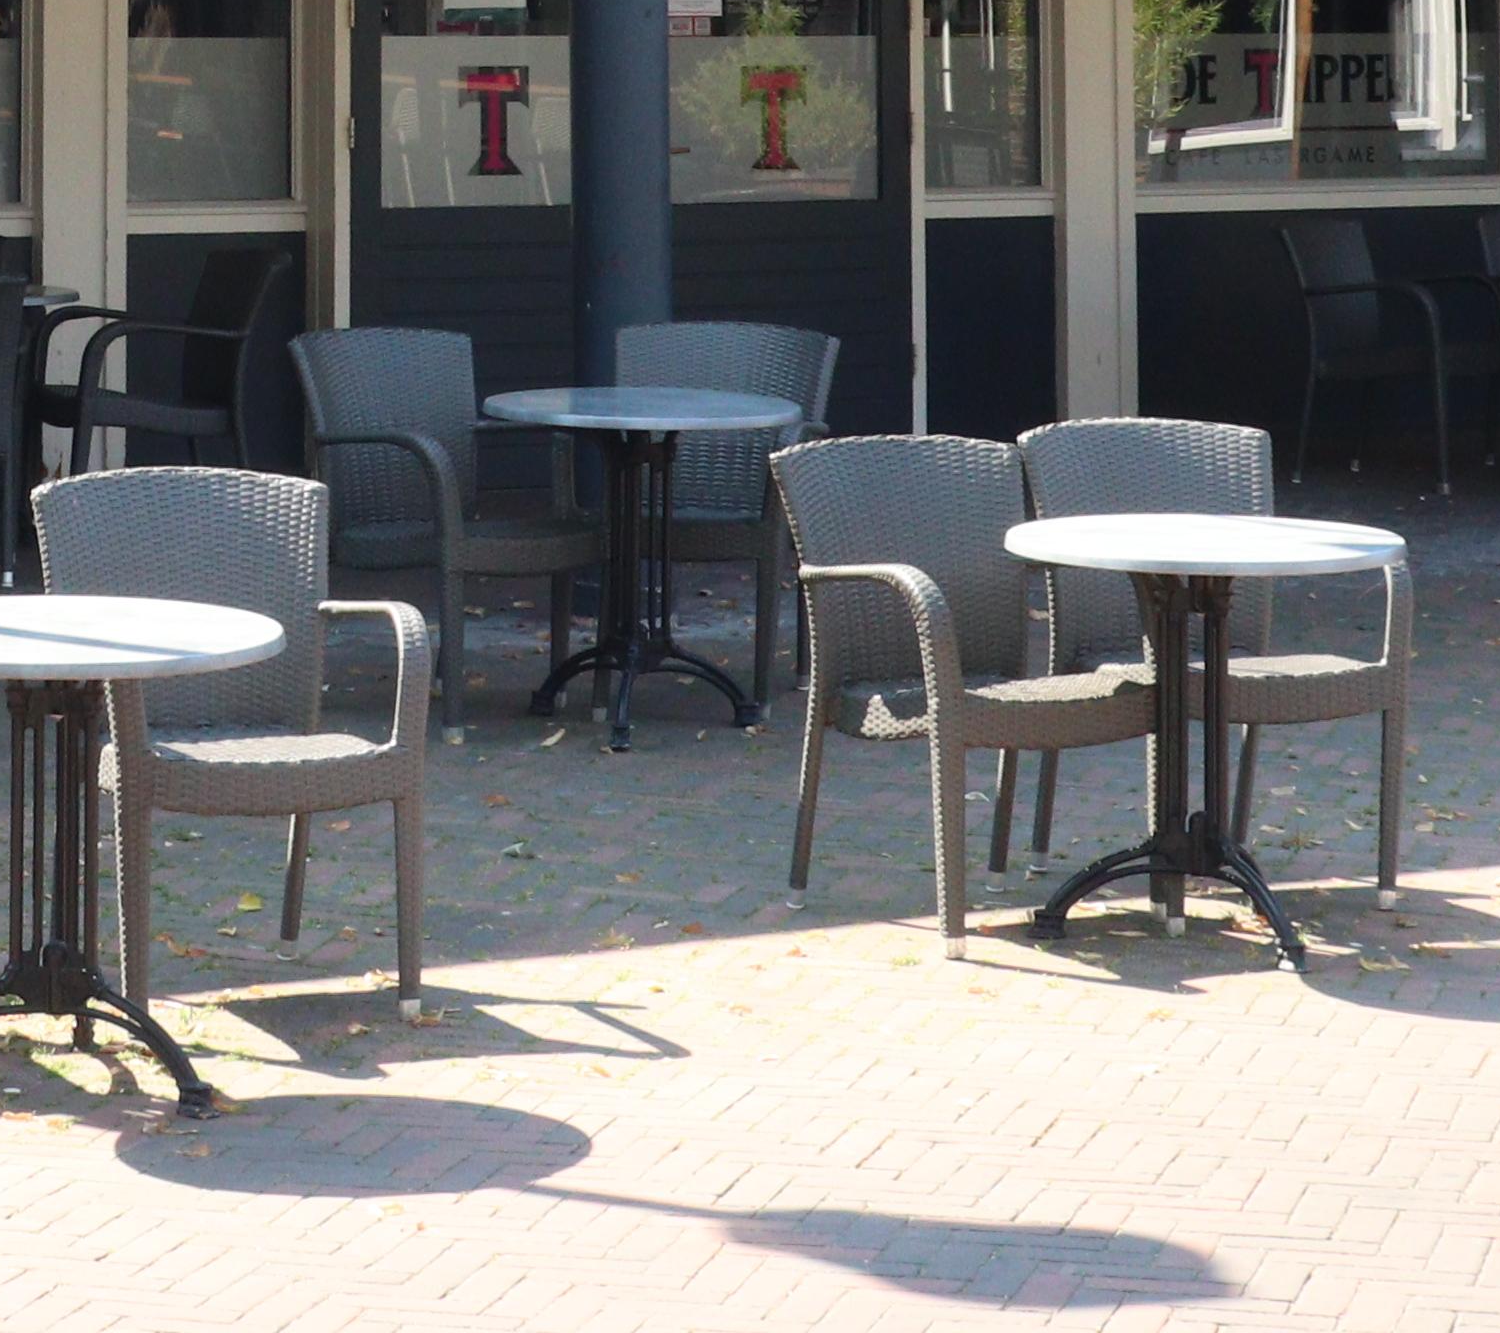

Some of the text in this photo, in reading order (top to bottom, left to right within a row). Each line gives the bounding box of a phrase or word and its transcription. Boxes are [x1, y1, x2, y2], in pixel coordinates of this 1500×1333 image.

[458, 65, 529, 176] T
[739, 64, 806, 171] T
[1245, 145, 1376, 166] LASRGAME
